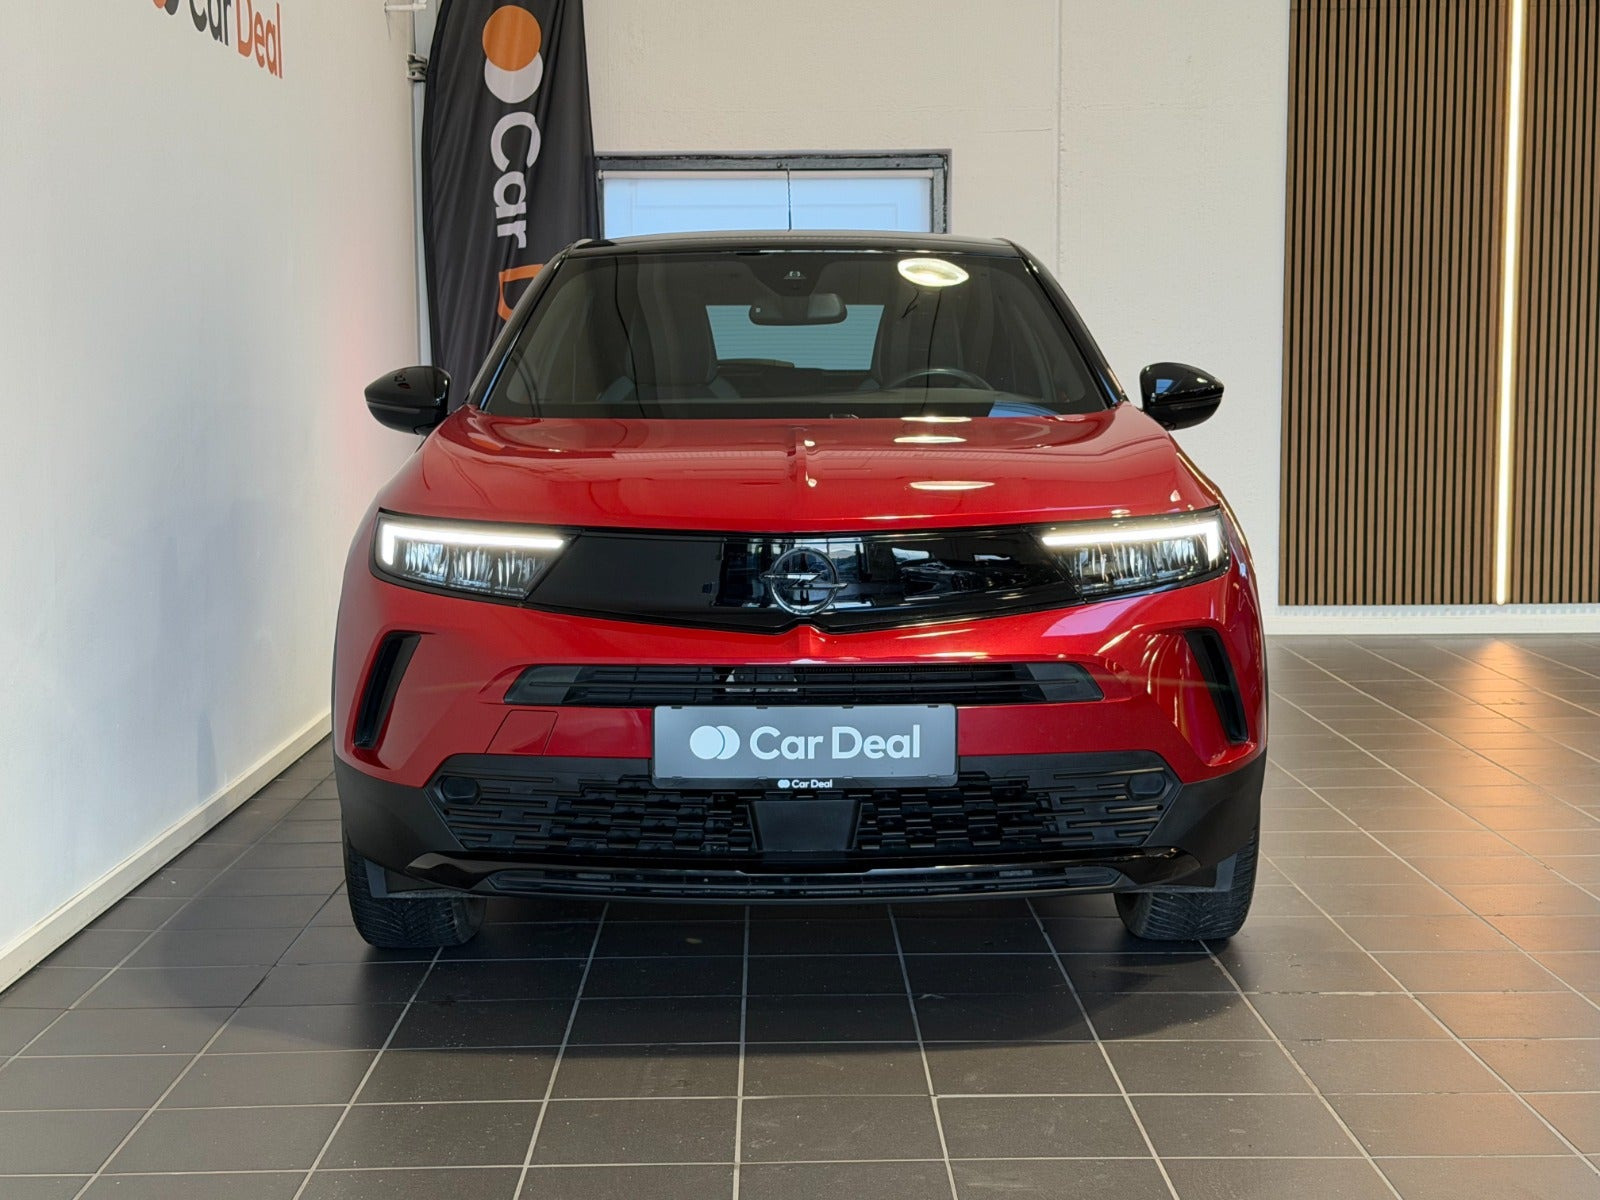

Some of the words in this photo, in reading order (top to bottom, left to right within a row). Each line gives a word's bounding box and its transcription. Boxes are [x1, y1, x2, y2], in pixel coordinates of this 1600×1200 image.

[236, 0, 283, 79] Deal
[490, 111, 541, 249] Car
[749, 725, 824, 760] Car
[831, 723, 921, 759] Deal
[791, 779, 809, 789] Car
[810, 779, 832, 789] Deal
